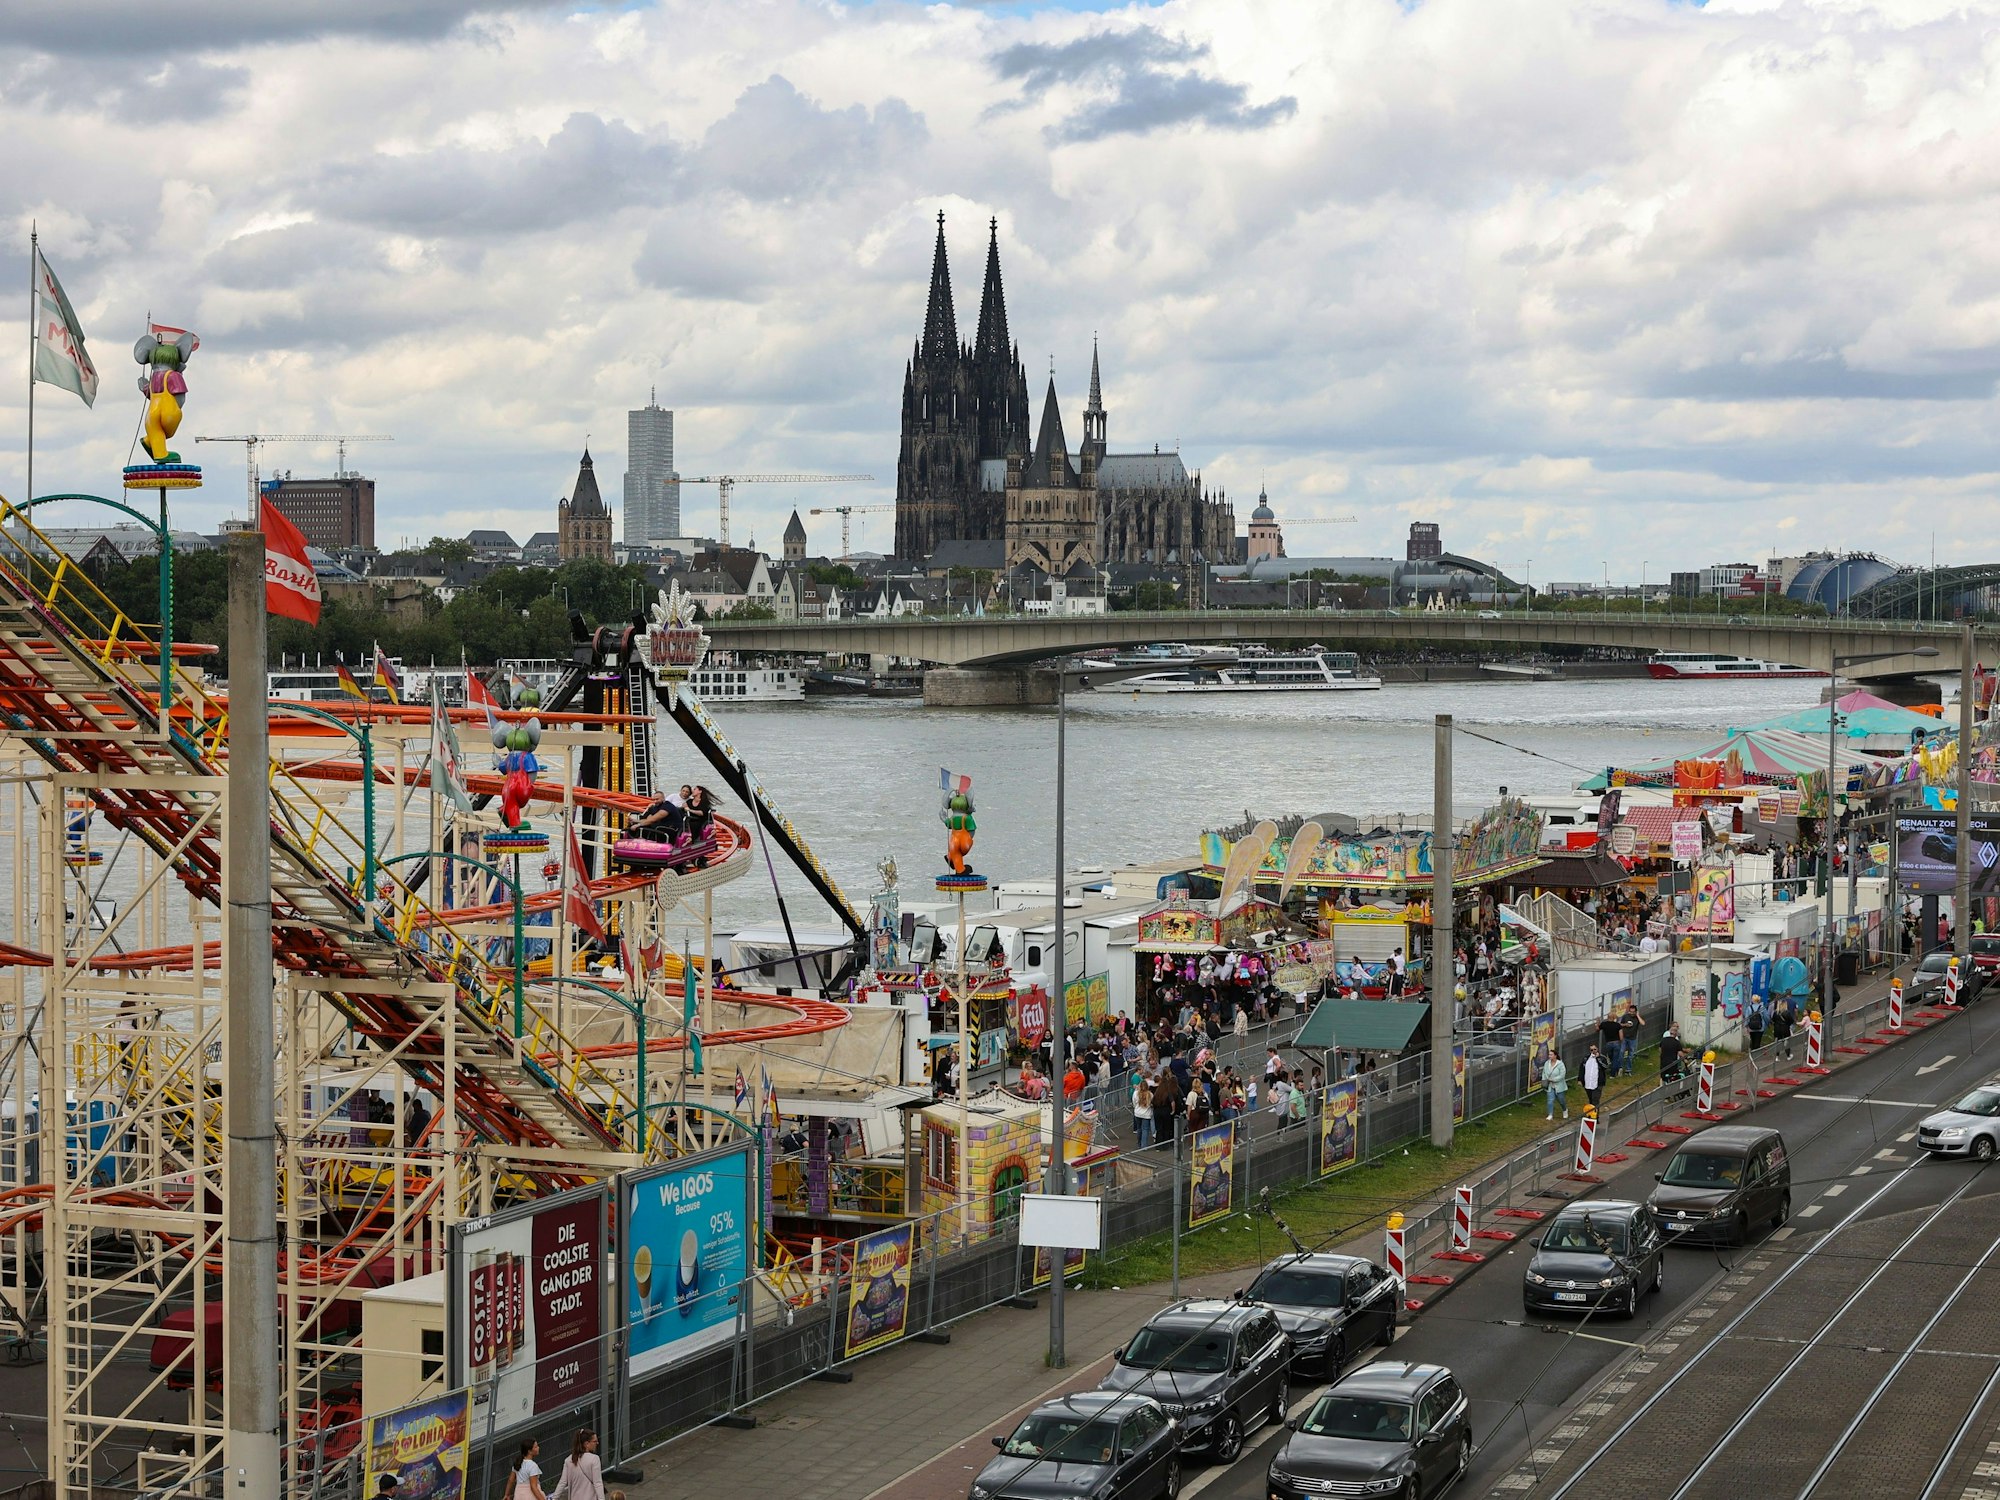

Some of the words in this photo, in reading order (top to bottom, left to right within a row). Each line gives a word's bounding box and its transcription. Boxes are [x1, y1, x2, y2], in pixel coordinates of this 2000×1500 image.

[264, 556, 318, 594] Barth
[1900, 819, 1938, 827] RENAULT
[1021, 1001, 1045, 1029] früh
[660, 1182, 680, 1207] We
[682, 1171, 714, 1201] IQOS
[675, 1201, 701, 1215] Because
[558, 1222, 576, 1243] DIE
[710, 1210, 734, 1235] 95%
[543, 1242, 590, 1271] COOLSTE
[540, 1272, 570, 1296] GANG
[571, 1265, 592, 1287] DER
[474, 1272, 486, 1362] COSTA
[550, 1292, 583, 1317] STADT.
[553, 1361, 580, 1382] COSTA
[559, 1378, 574, 1389] COFFEE
[392, 1424, 445, 1456] COLONIA
